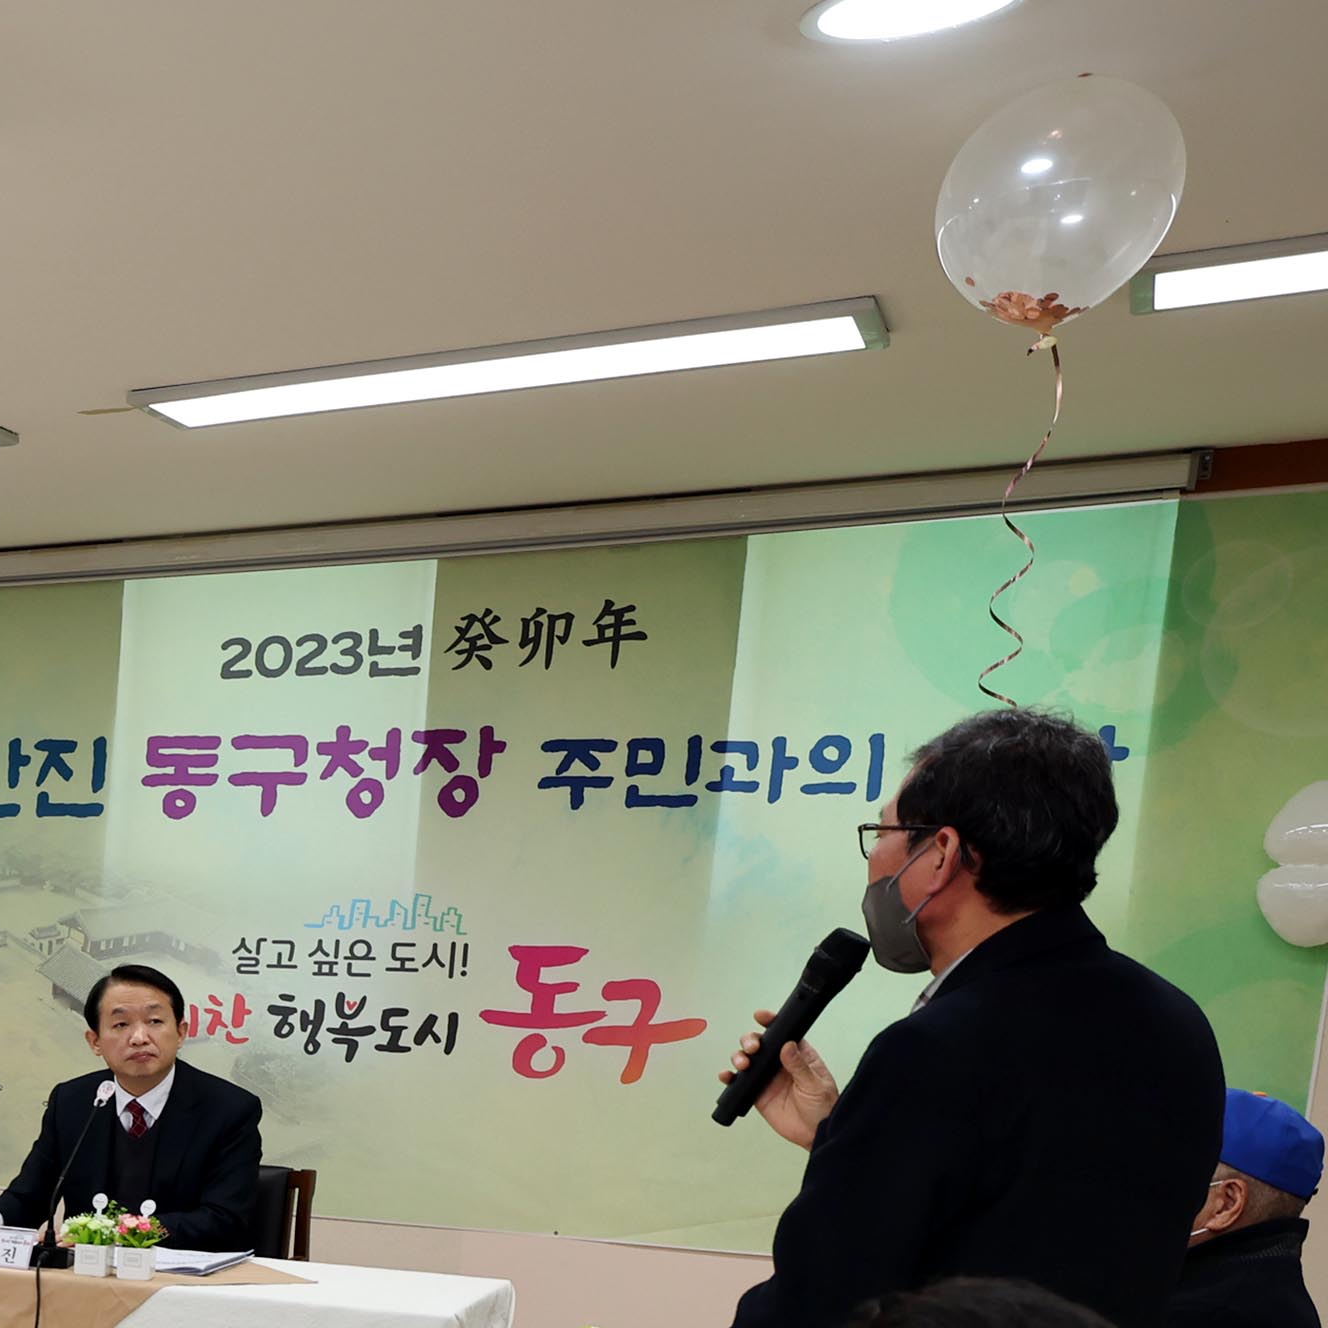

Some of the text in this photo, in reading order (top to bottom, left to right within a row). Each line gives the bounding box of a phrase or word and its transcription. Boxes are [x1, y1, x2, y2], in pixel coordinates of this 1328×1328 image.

[220, 599, 648, 680] 2023년 癸卯年
[141, 725, 507, 820] 동구청장
[537, 732, 886, 809] 주민과의
[231, 936, 470, 978] 살고 싶은 도시!
[267, 992, 460, 1063] 행복도시
[479, 944, 708, 1085] 동구
